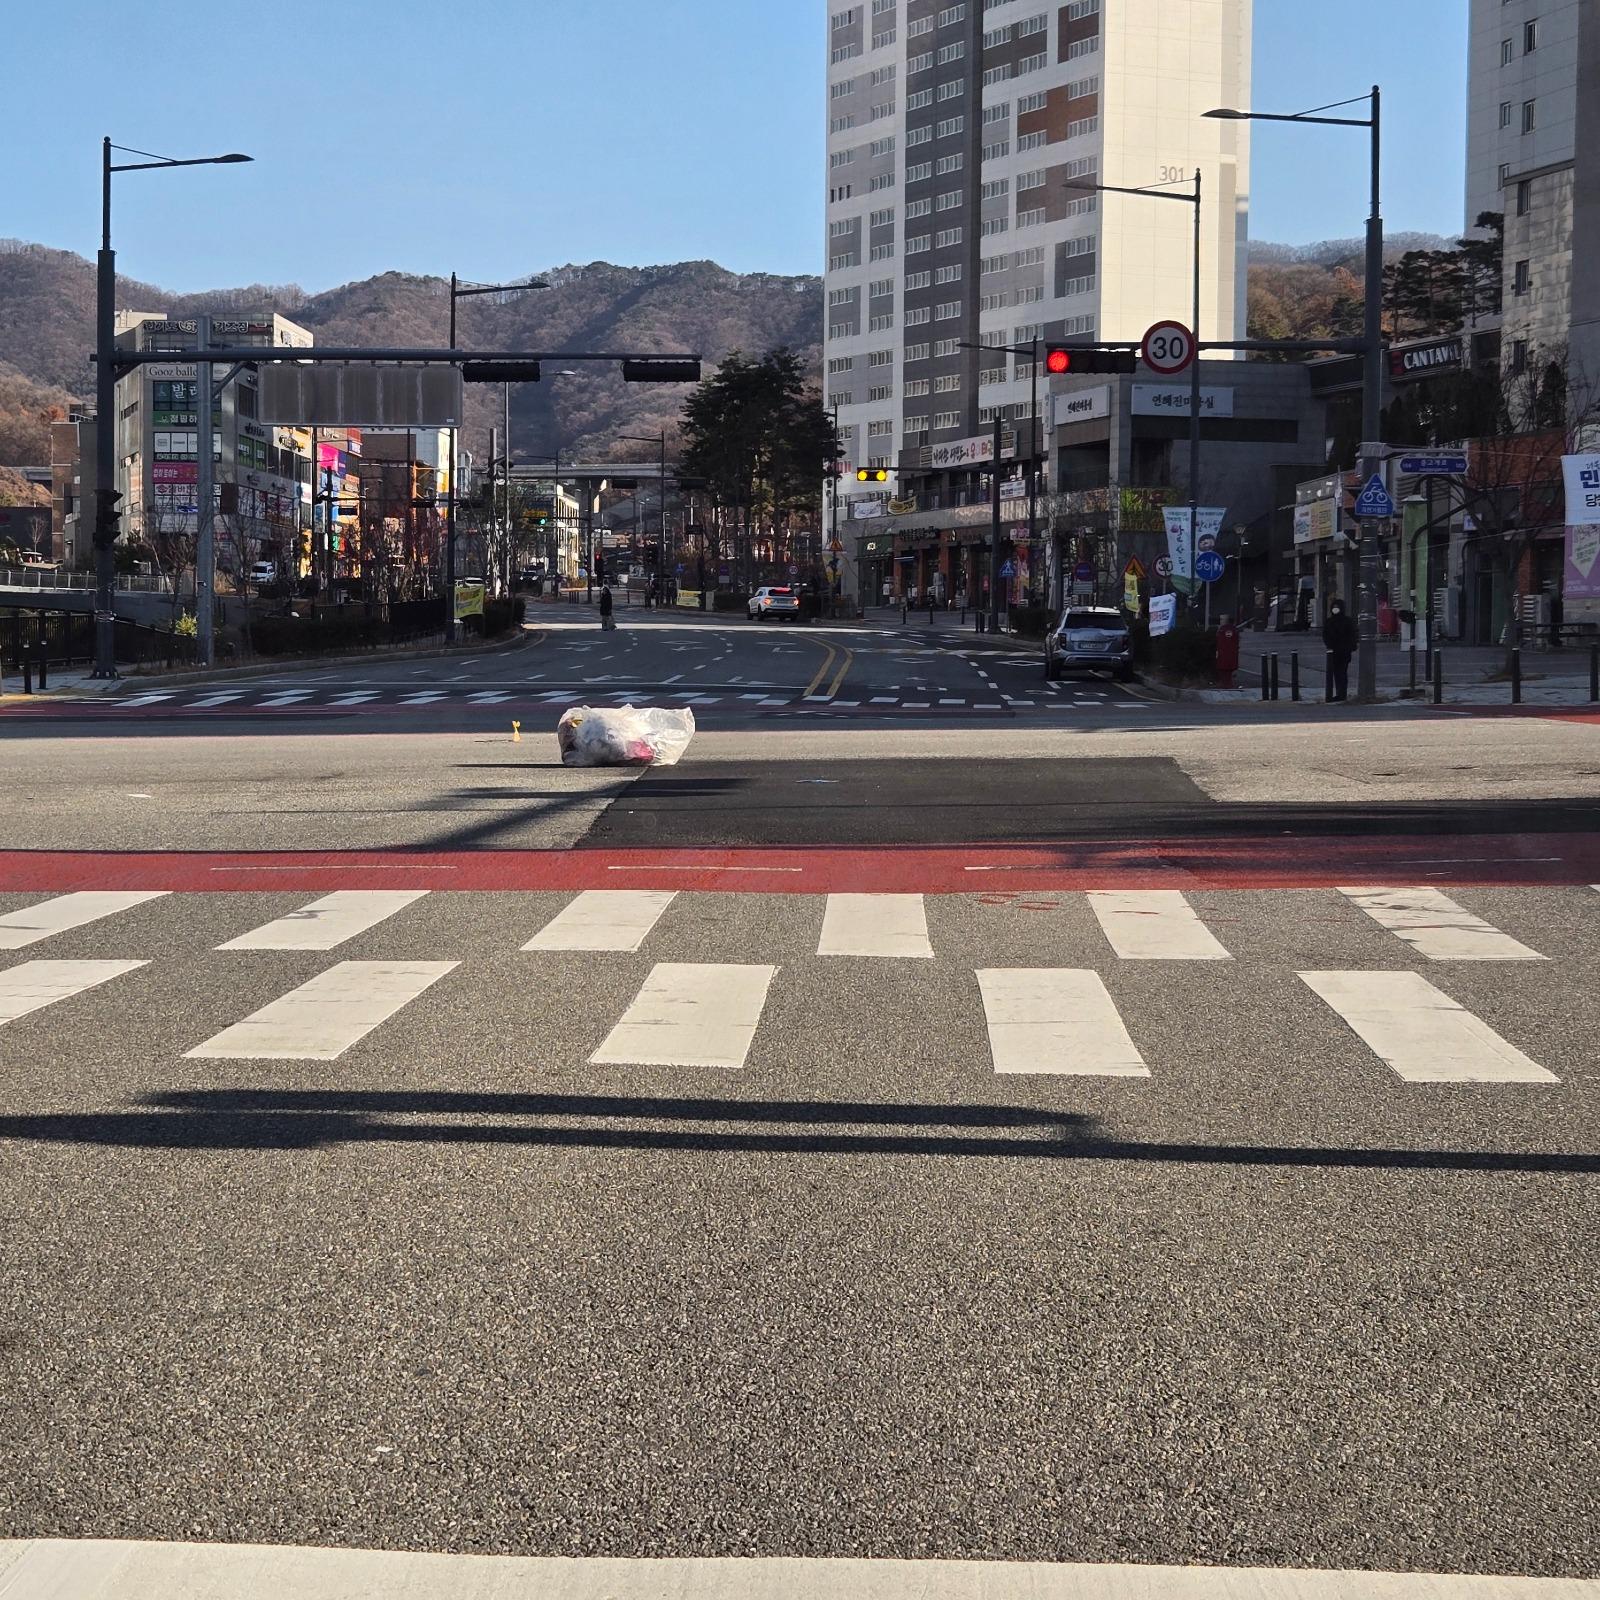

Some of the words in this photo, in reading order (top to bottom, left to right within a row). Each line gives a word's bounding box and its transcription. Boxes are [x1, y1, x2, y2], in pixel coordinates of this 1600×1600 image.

[1159, 166, 1185, 182] 301
[1152, 336, 1184, 360] 30
[149, 366, 174, 376] Gooz
